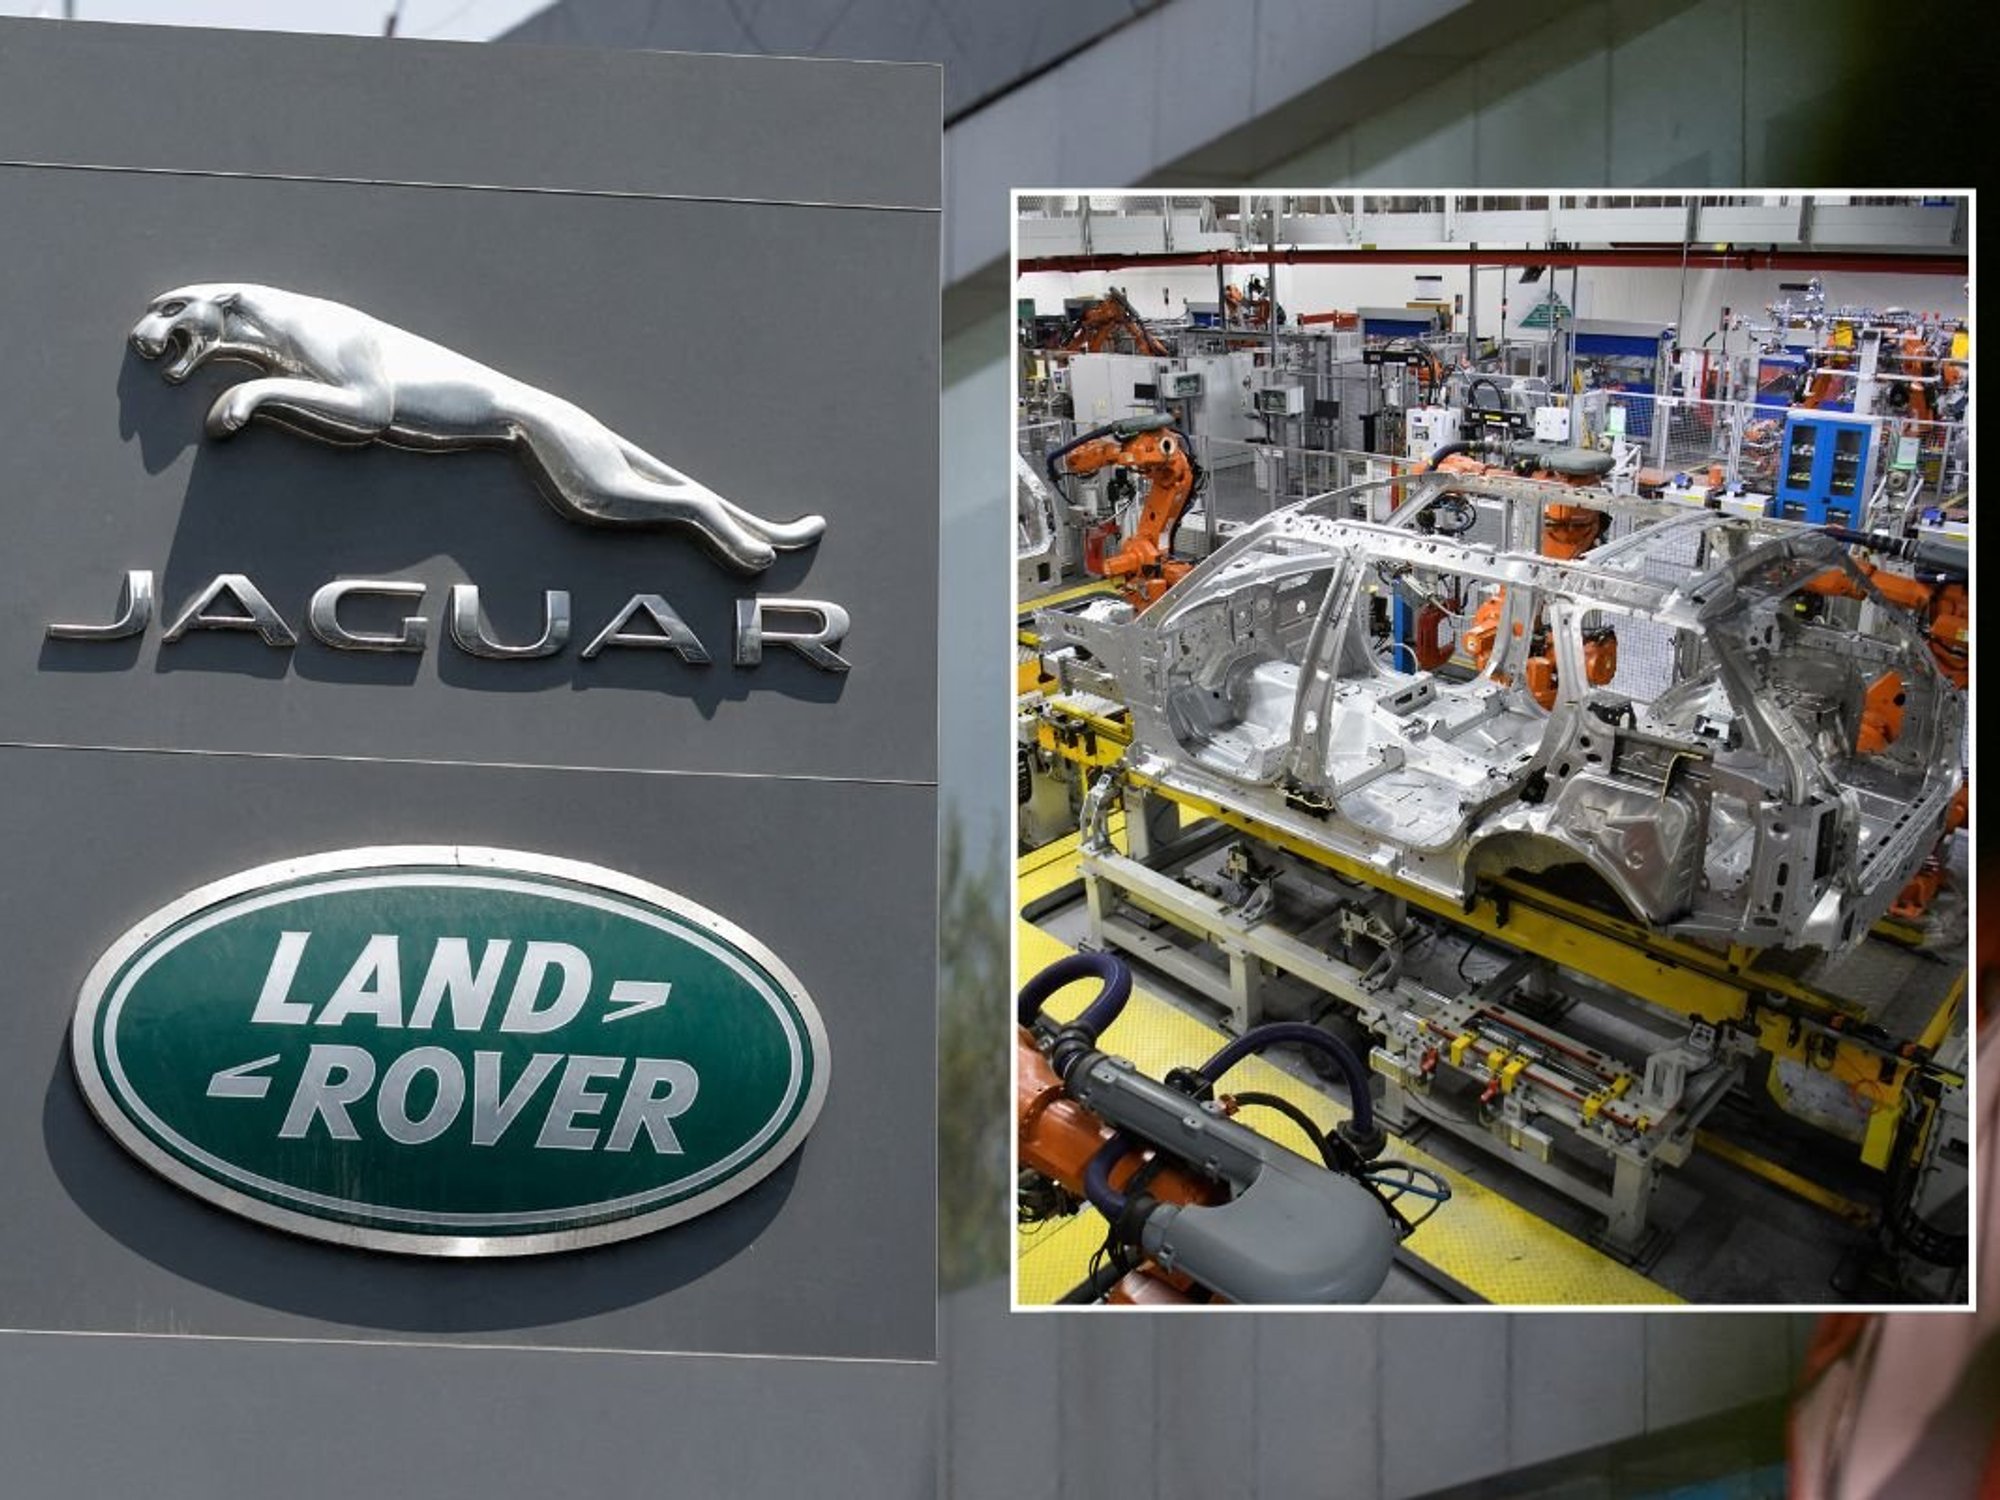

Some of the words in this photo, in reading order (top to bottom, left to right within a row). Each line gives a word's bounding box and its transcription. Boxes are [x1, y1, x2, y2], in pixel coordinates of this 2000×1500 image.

[47, 569, 851, 671] JAGUAR
[250, 931, 592, 1033] LAND
[278, 1044, 699, 1155] ROVER
